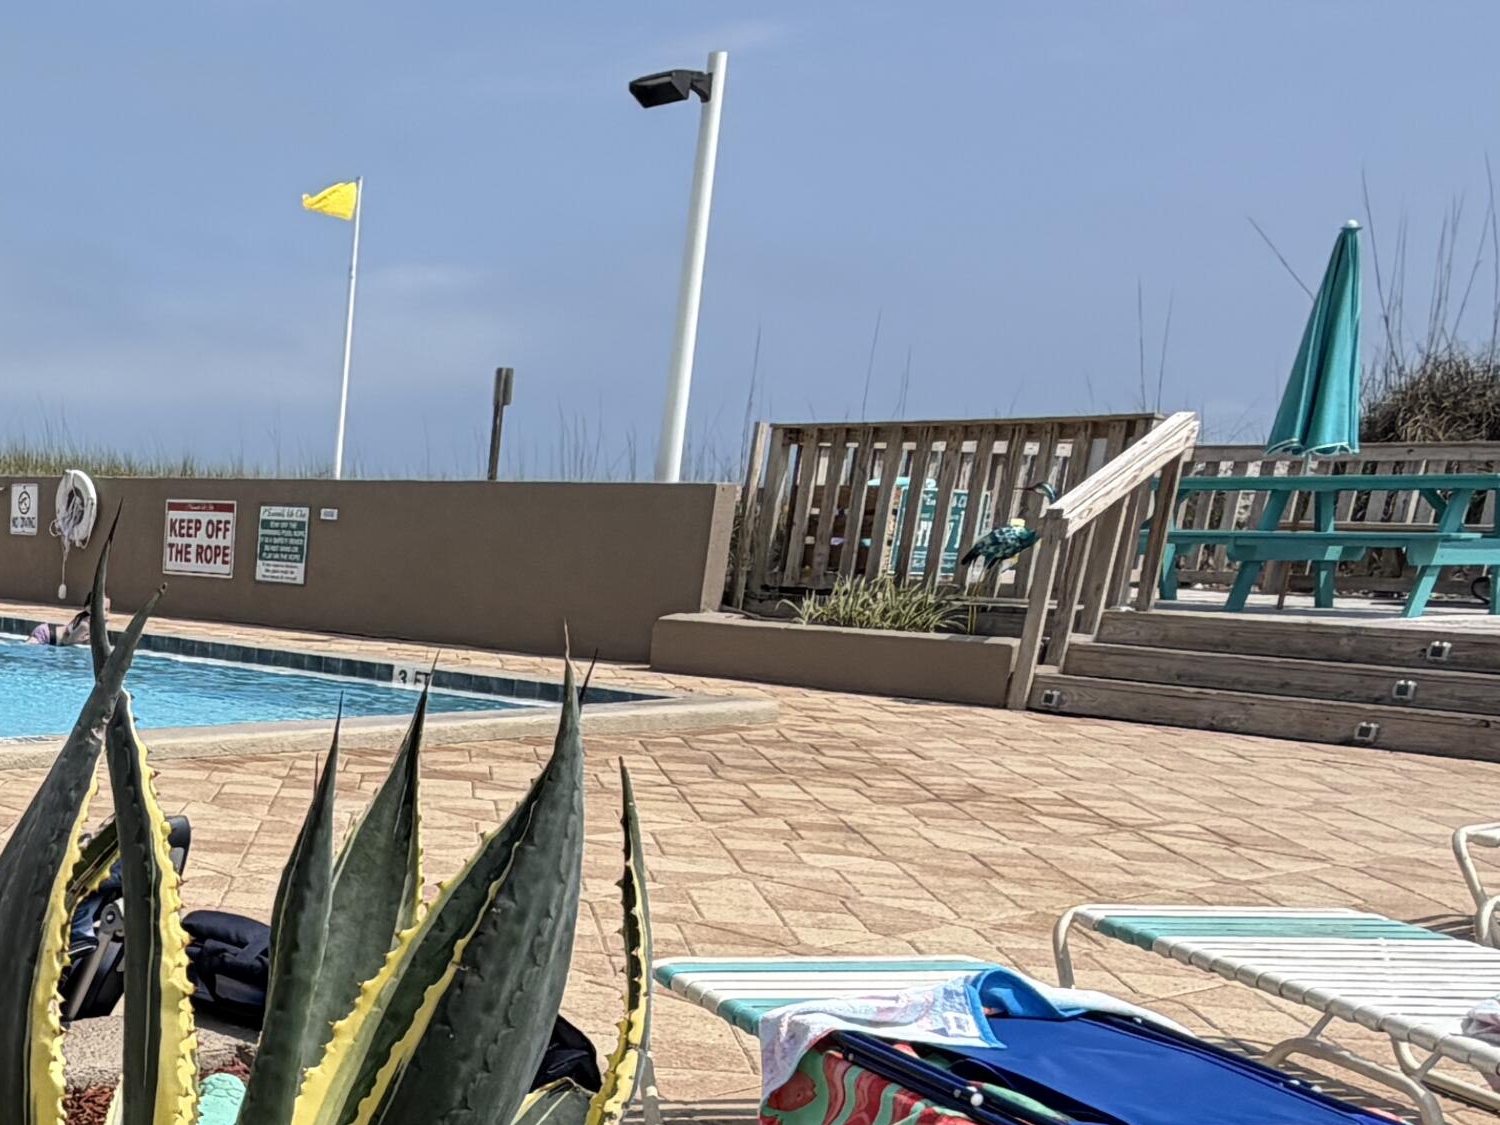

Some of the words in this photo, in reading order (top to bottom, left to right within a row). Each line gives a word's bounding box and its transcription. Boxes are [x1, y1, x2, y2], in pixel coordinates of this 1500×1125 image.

[169, 518, 202, 539] KEEP
[206, 519, 231, 540] OFF
[167, 543, 192, 563] THE
[196, 544, 230, 565] ROPE
[399, 670, 407, 684] 3
